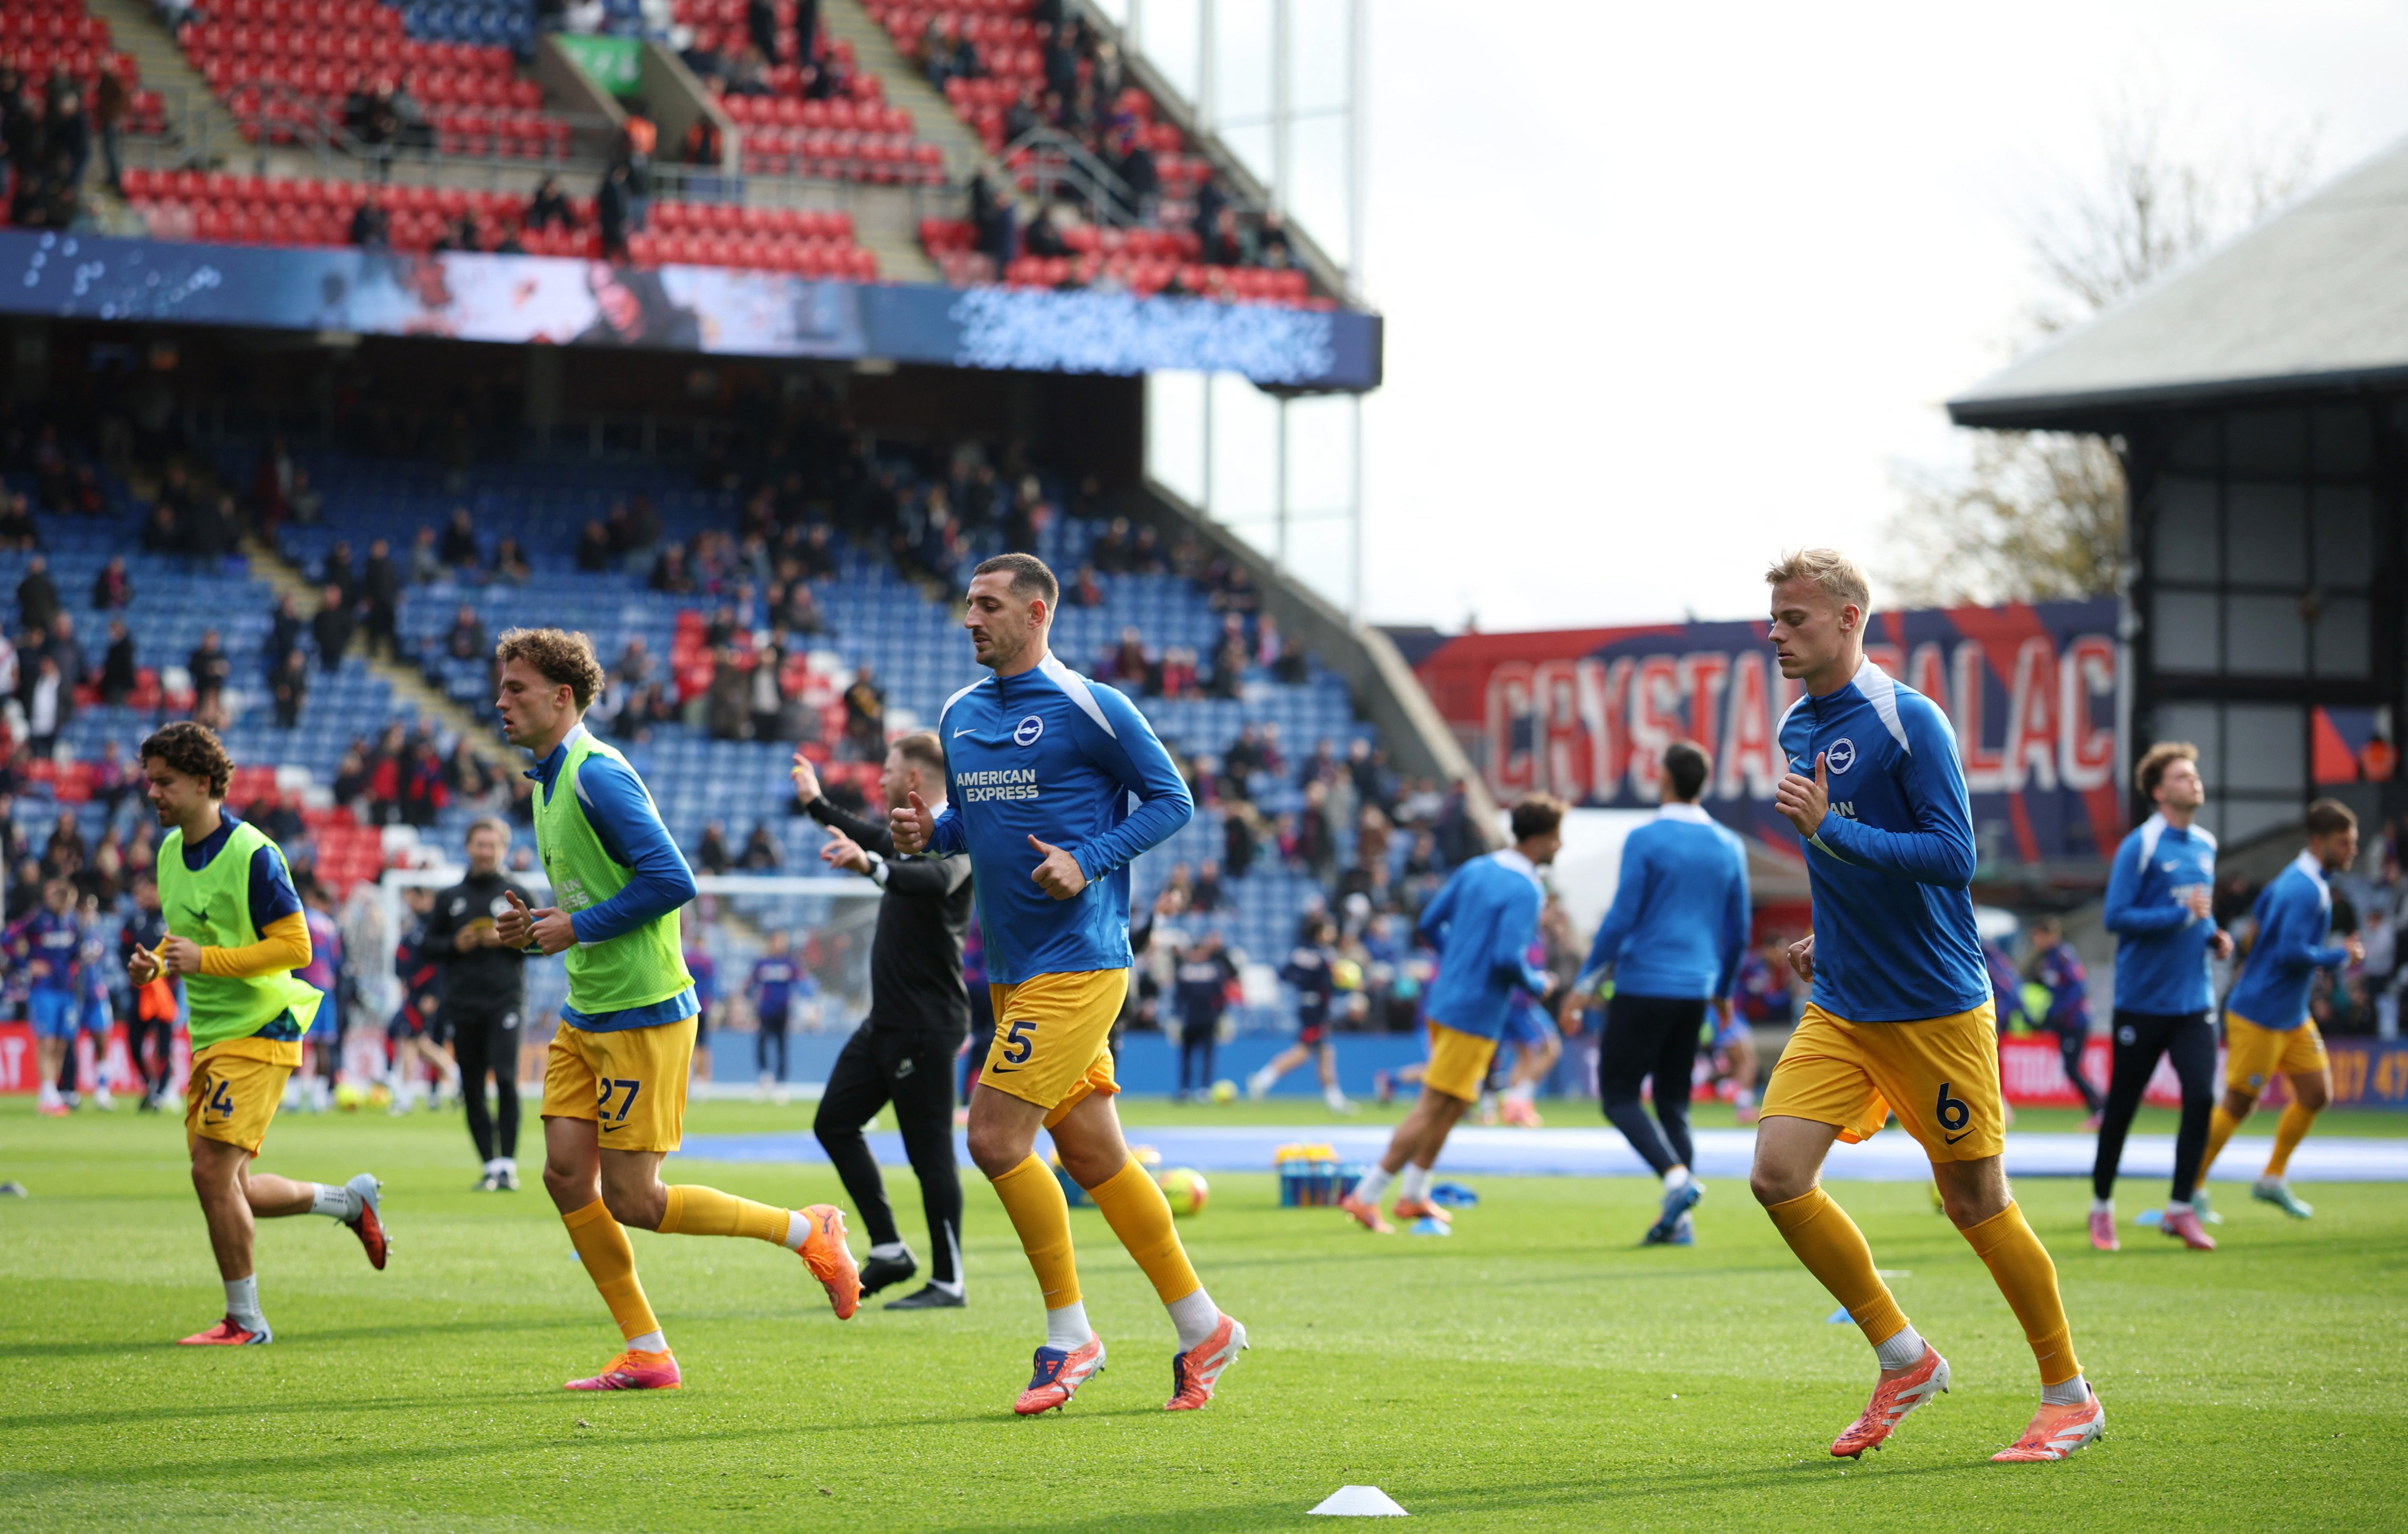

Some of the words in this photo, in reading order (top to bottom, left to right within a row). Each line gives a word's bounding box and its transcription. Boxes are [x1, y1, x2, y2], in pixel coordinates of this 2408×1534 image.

[1485, 650, 1797, 807] CRYSTA
[1863, 635, 2116, 794] ALAC
[957, 769, 1036, 787] AMERICAN
[966, 785, 1039, 802] EXPRESS
[1003, 1021, 1038, 1064] 5
[598, 1077, 640, 1122] 27
[1936, 1082, 1970, 1131] 6
